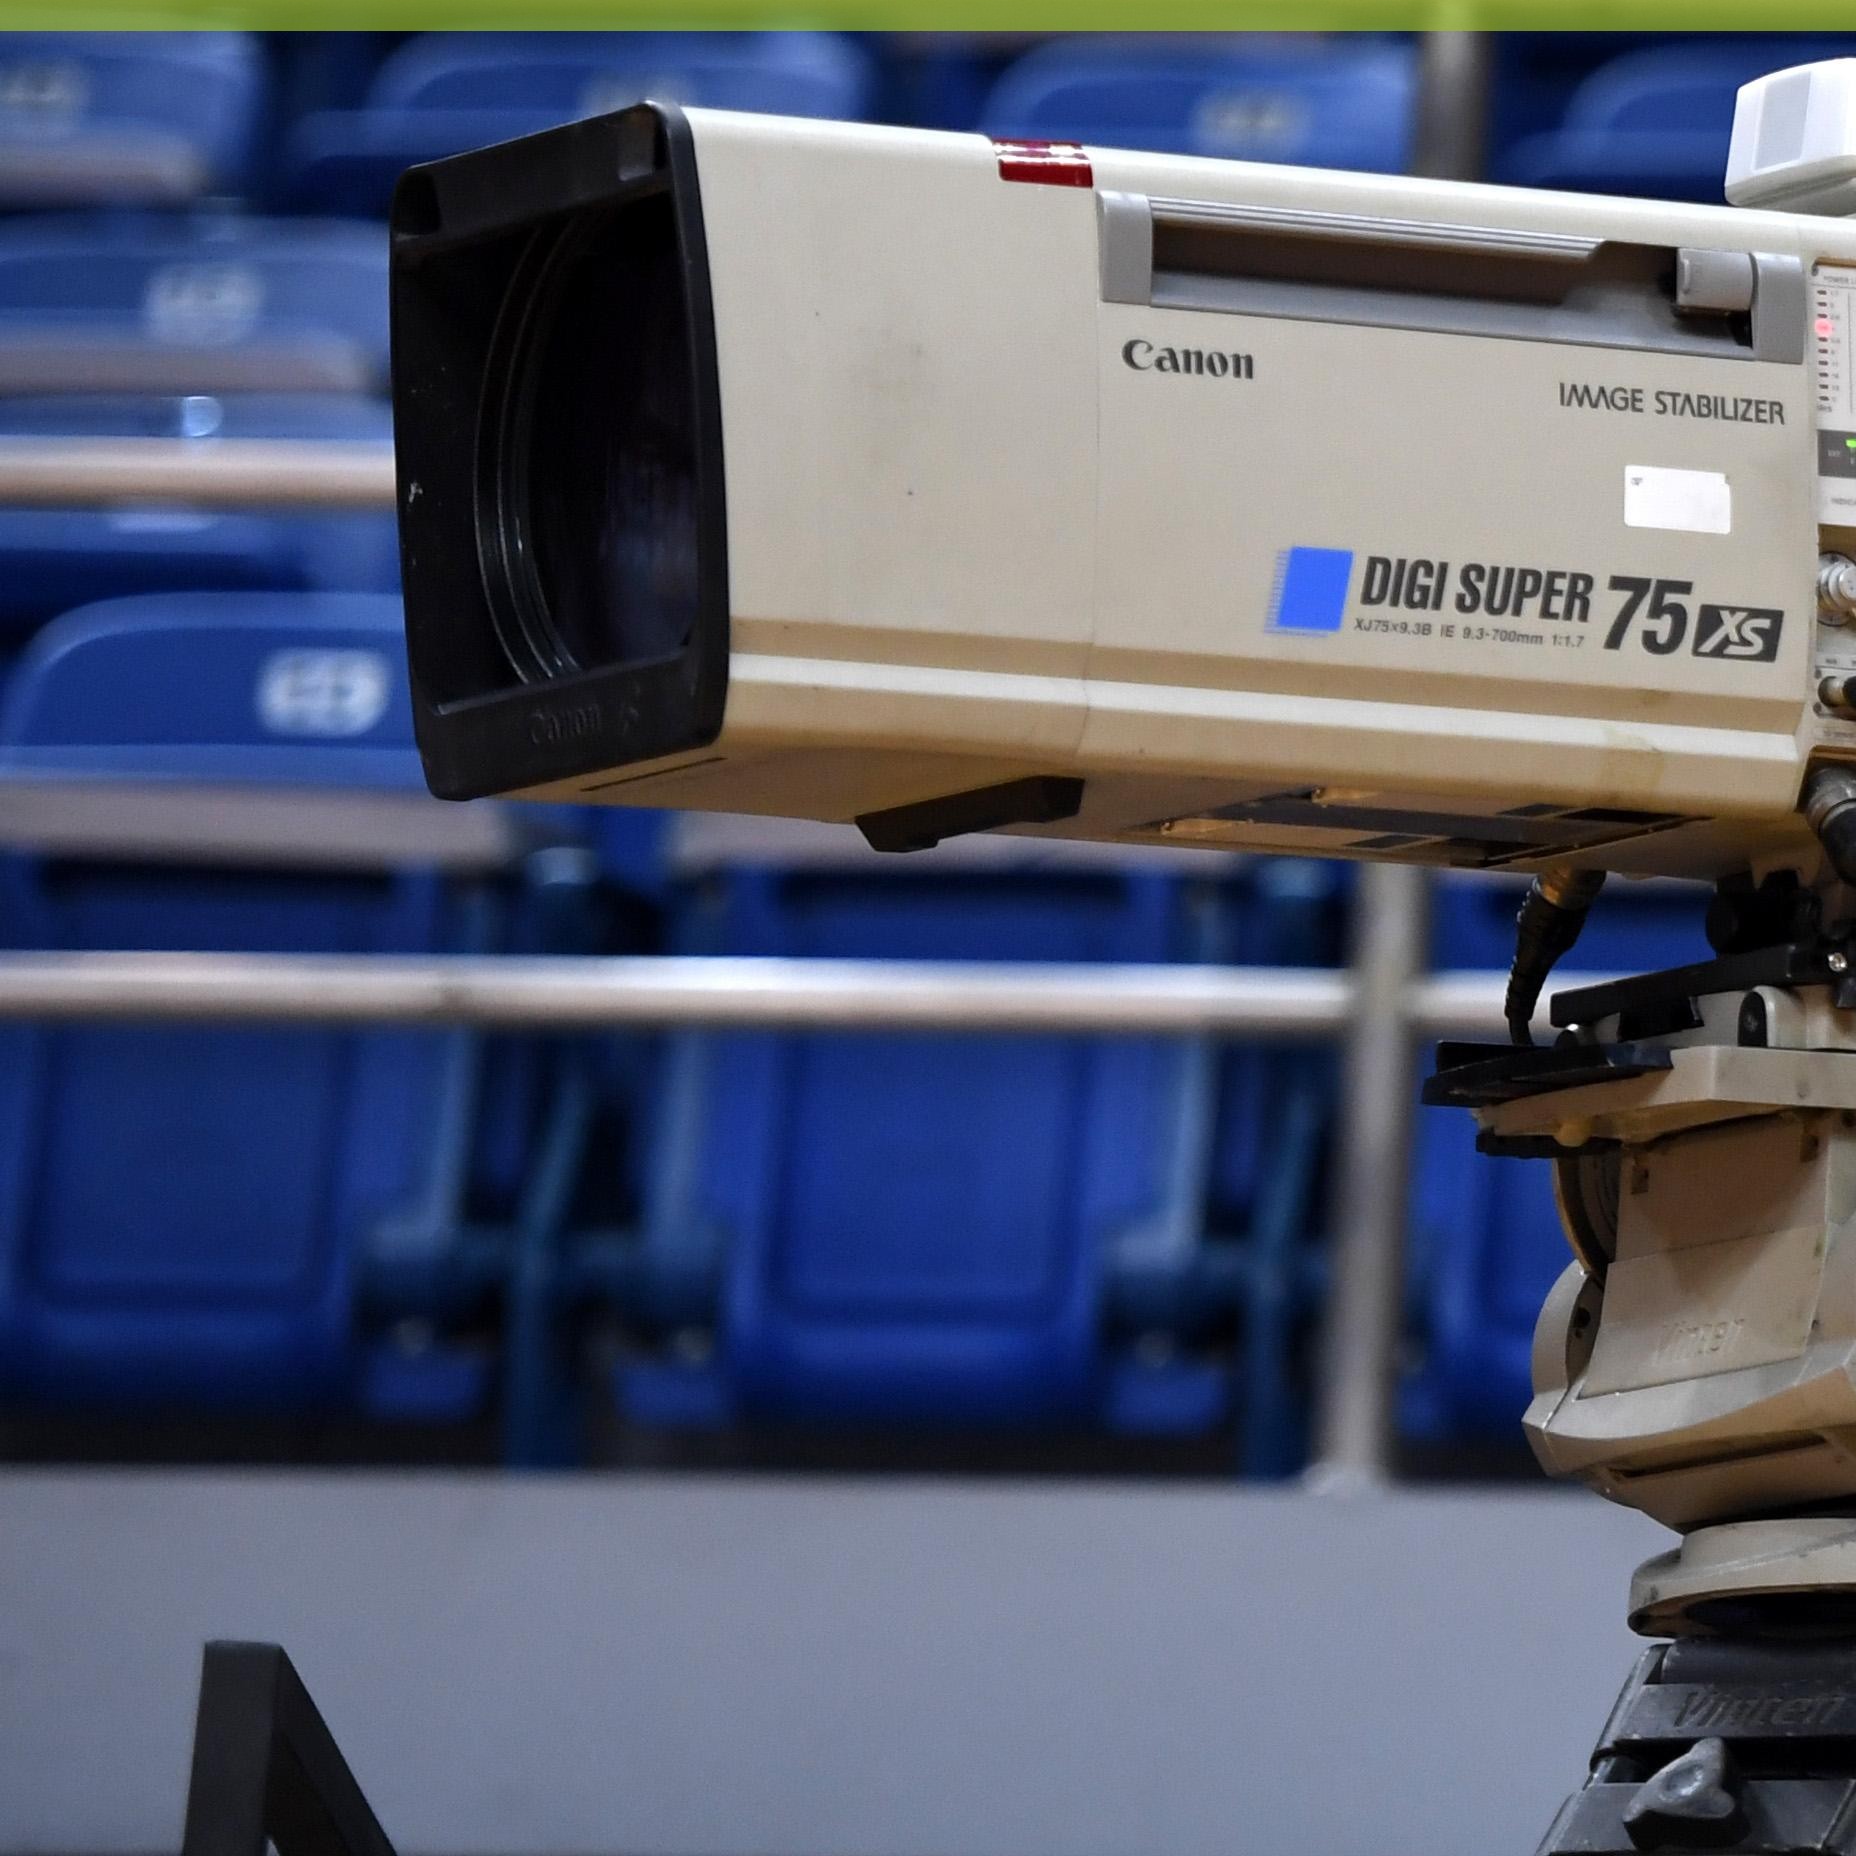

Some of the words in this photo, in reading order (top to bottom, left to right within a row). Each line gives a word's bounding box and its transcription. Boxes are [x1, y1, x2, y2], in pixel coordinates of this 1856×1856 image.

[1121, 338, 1254, 380] Canon
[1559, 382, 1644, 413] IMAGE
[1655, 390, 1785, 425] STABILIZER
[1360, 555, 1449, 612] DIGI
[1455, 563, 1595, 623] SUPER
[1603, 574, 1694, 656] 75
[1698, 609, 1772, 657] XS
[1440, 624, 1455, 639] IE
